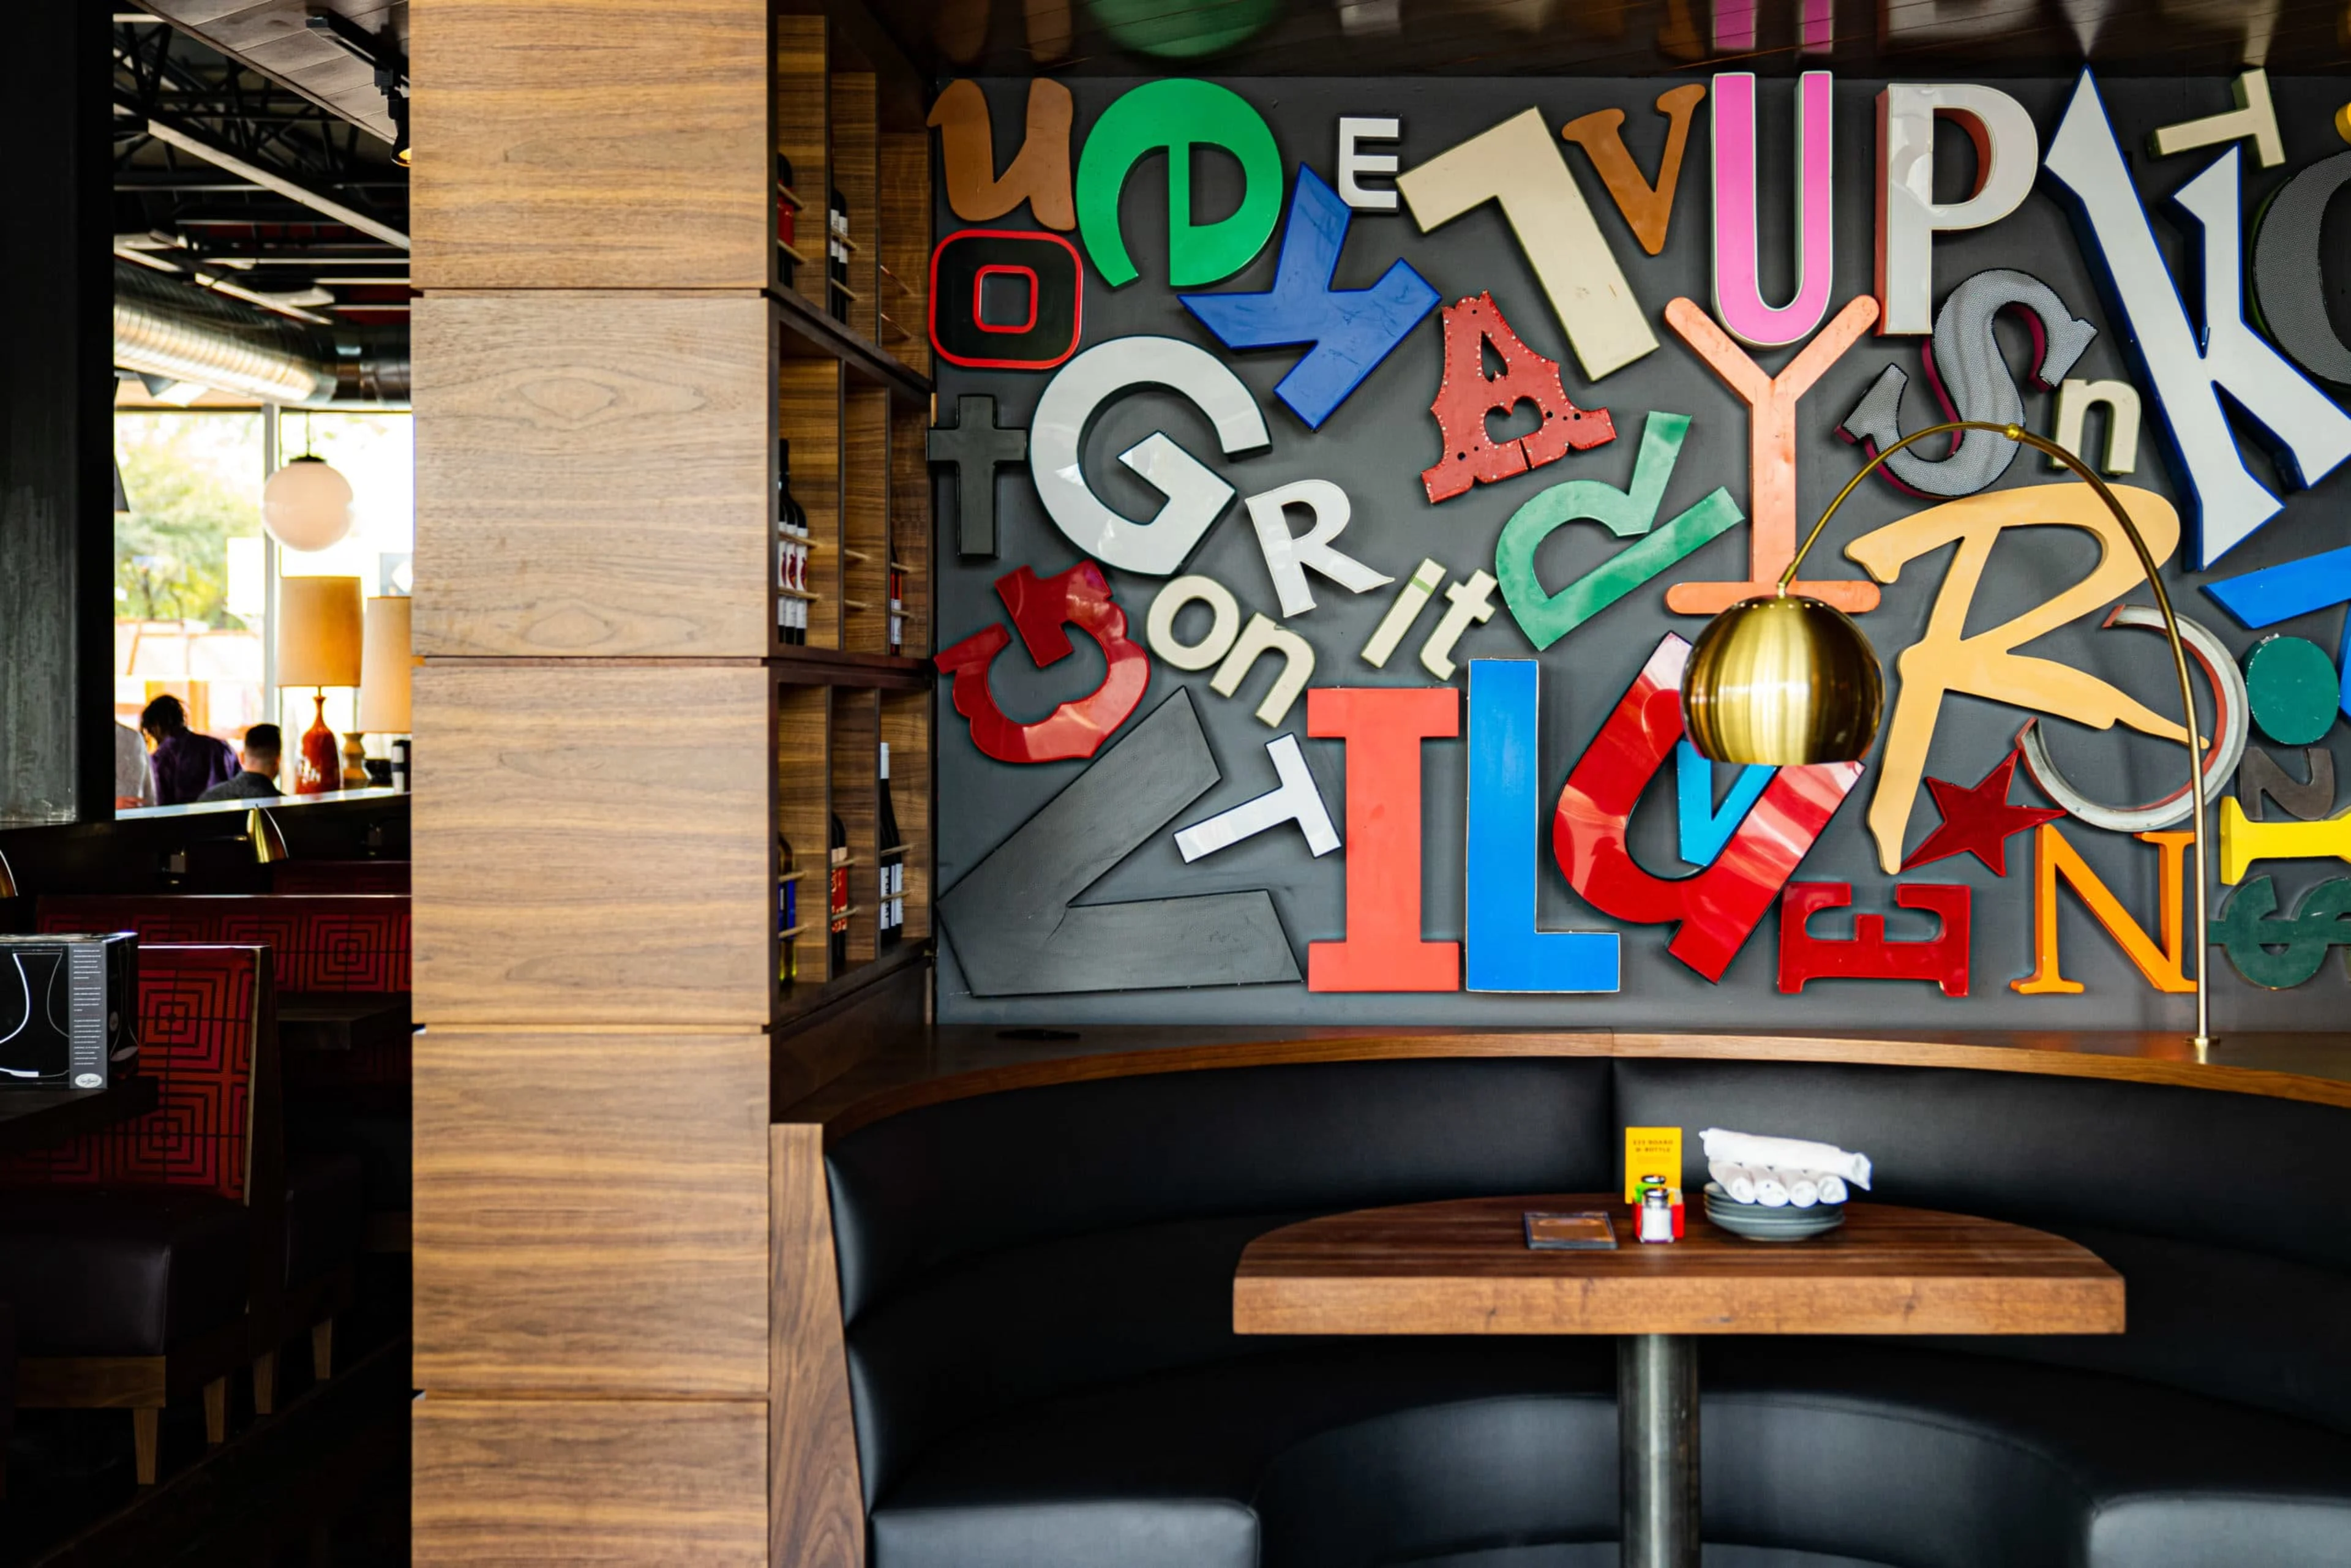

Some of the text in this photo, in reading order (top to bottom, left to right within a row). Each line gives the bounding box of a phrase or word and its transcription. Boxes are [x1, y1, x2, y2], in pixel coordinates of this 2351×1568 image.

[1339, 116, 1400, 208] E
[1561, 84, 1706, 255] V
[1710, 71, 1833, 348] U
[1875, 83, 2039, 336] P
[1420, 289, 1617, 504] A
[1835, 268, 2099, 500] S
[2042, 64, 2351, 572] K
[1030, 334, 1272, 576] G
[1245, 479, 1395, 618] R
[1665, 297, 1881, 615] Y
[1844, 481, 2210, 876] R
[1173, 732, 1342, 865] T
[1308, 688, 1460, 992] I
[1466, 658, 1621, 993] L
[2009, 823, 2199, 993] N
[1777, 881, 1971, 998] E
